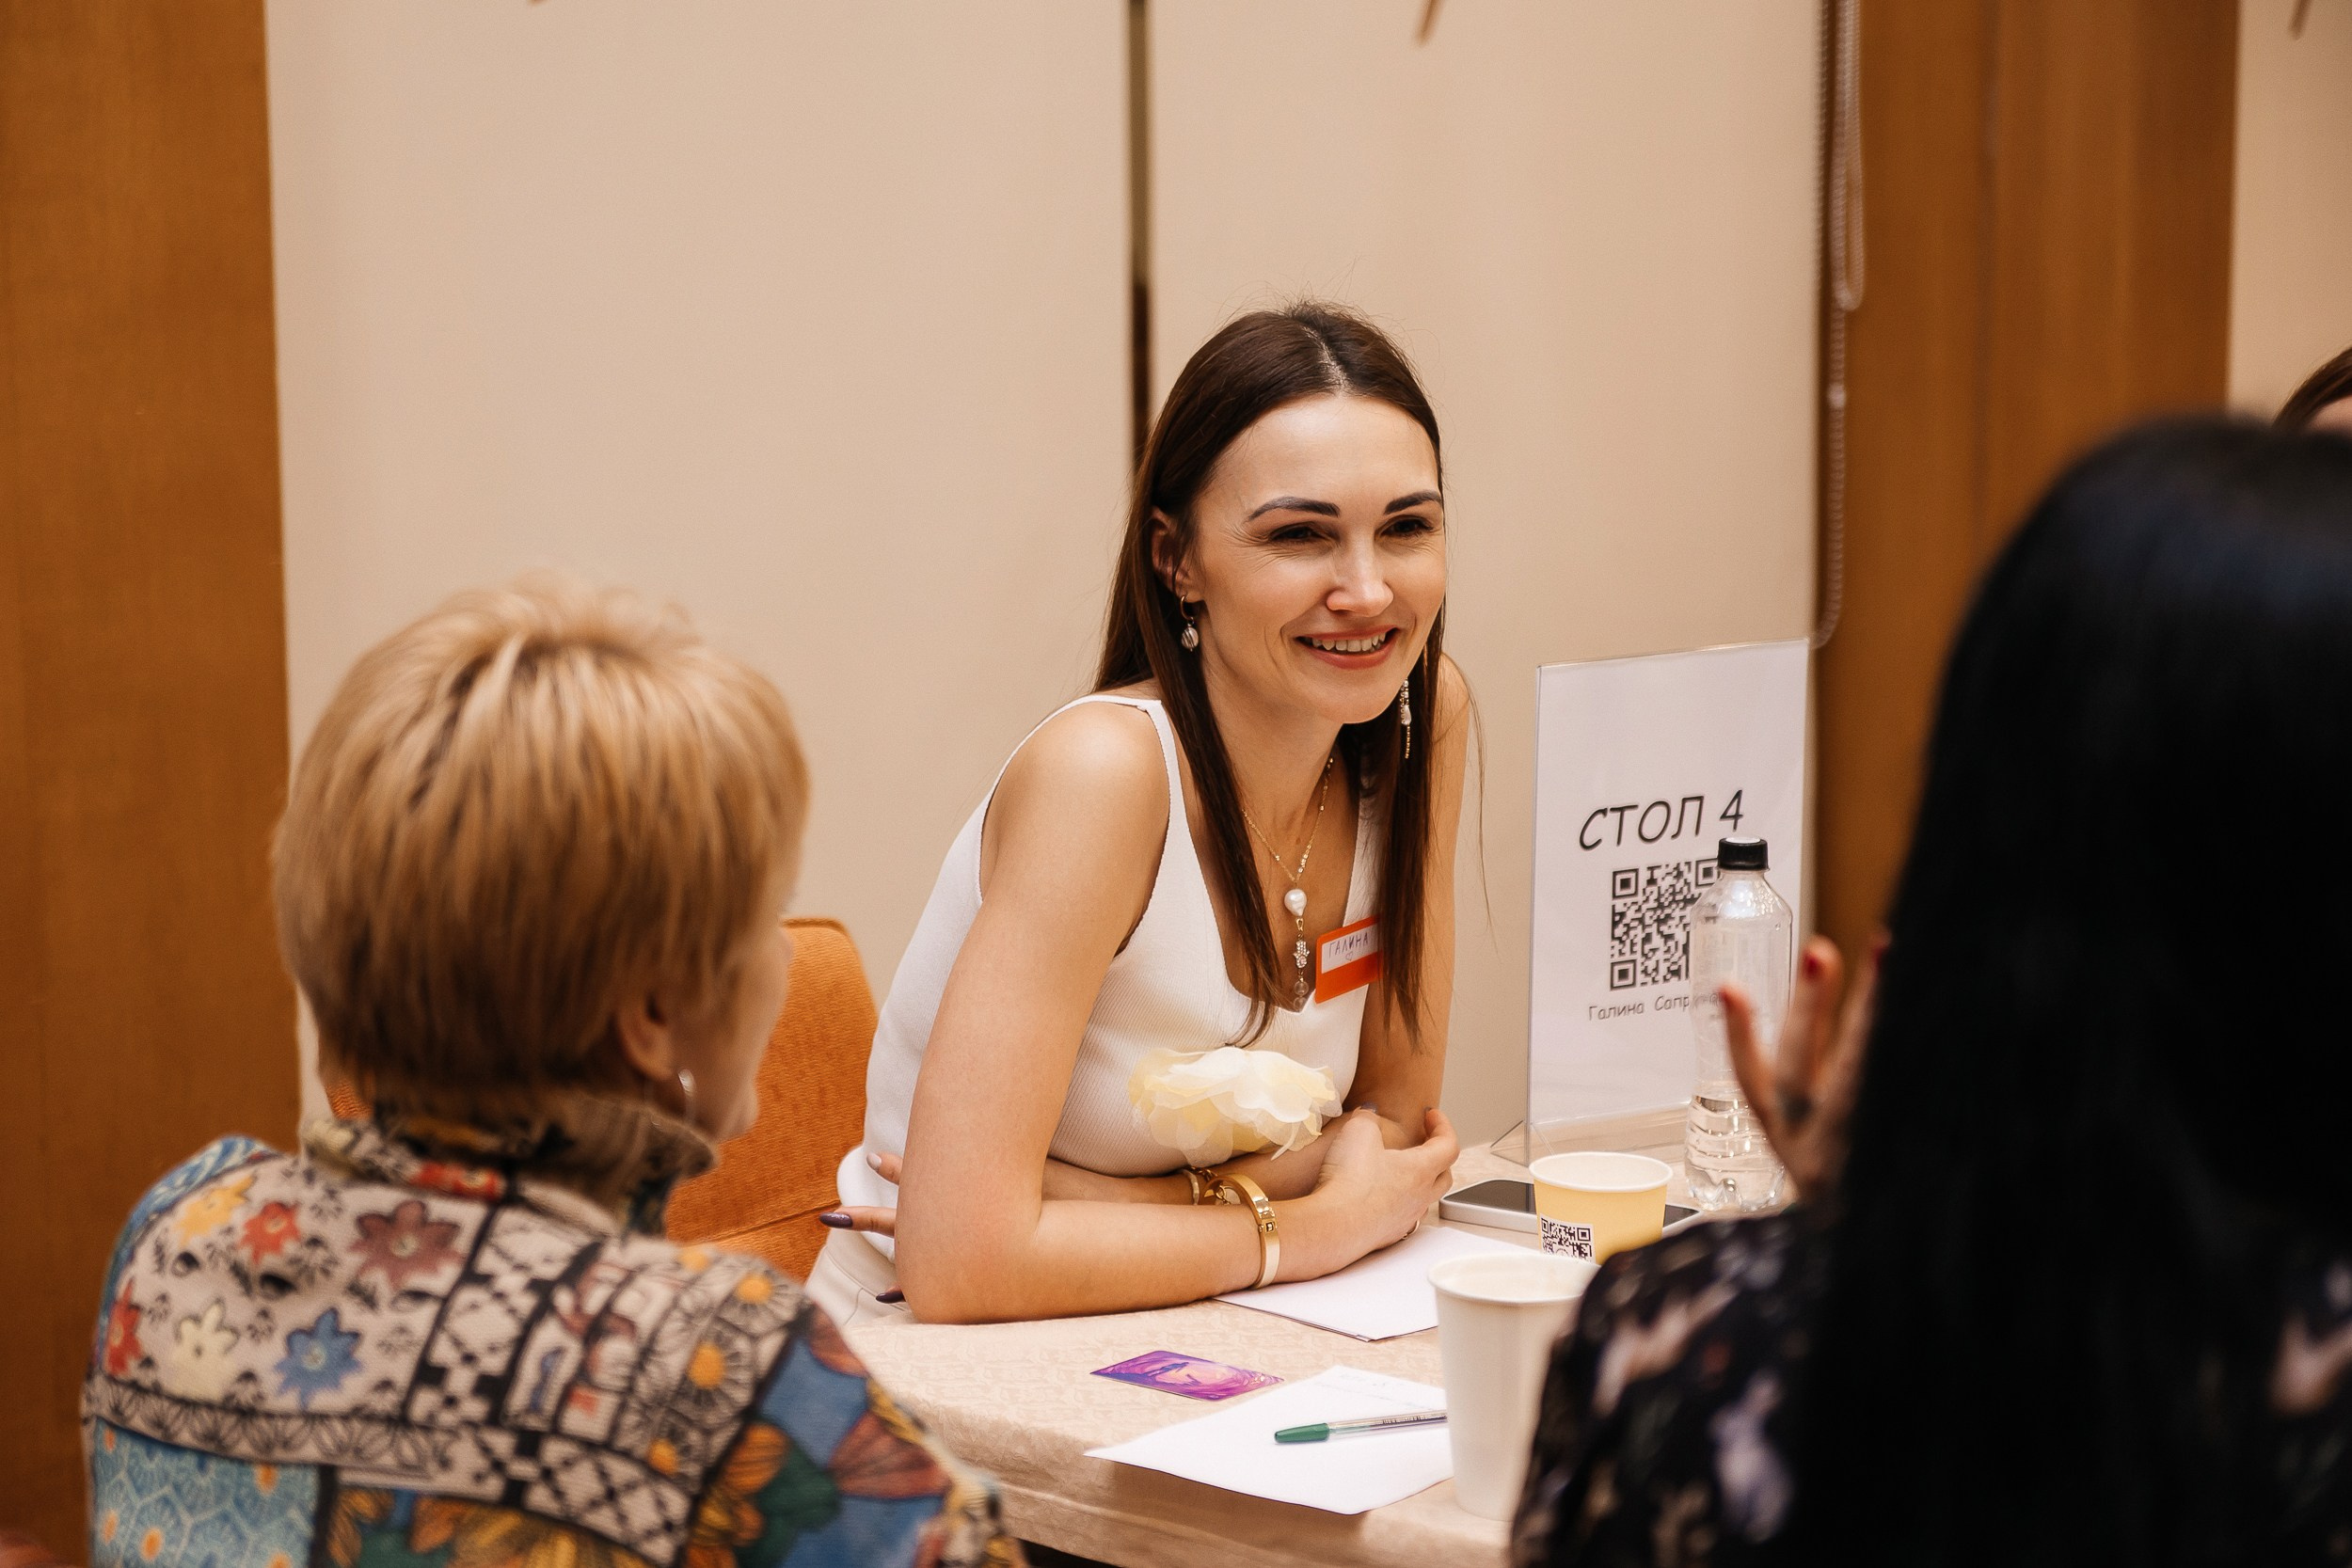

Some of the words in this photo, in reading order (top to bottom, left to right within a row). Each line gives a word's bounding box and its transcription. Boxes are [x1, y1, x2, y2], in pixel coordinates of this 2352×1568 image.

[1579, 795, 1705, 851] СТОЛ
[1719, 789, 1744, 832] 4
[1328, 931, 1369, 958] ГАЛИНА
[1588, 1002, 1645, 1022] Галина
[1654, 991, 1720, 1013] Сапр
